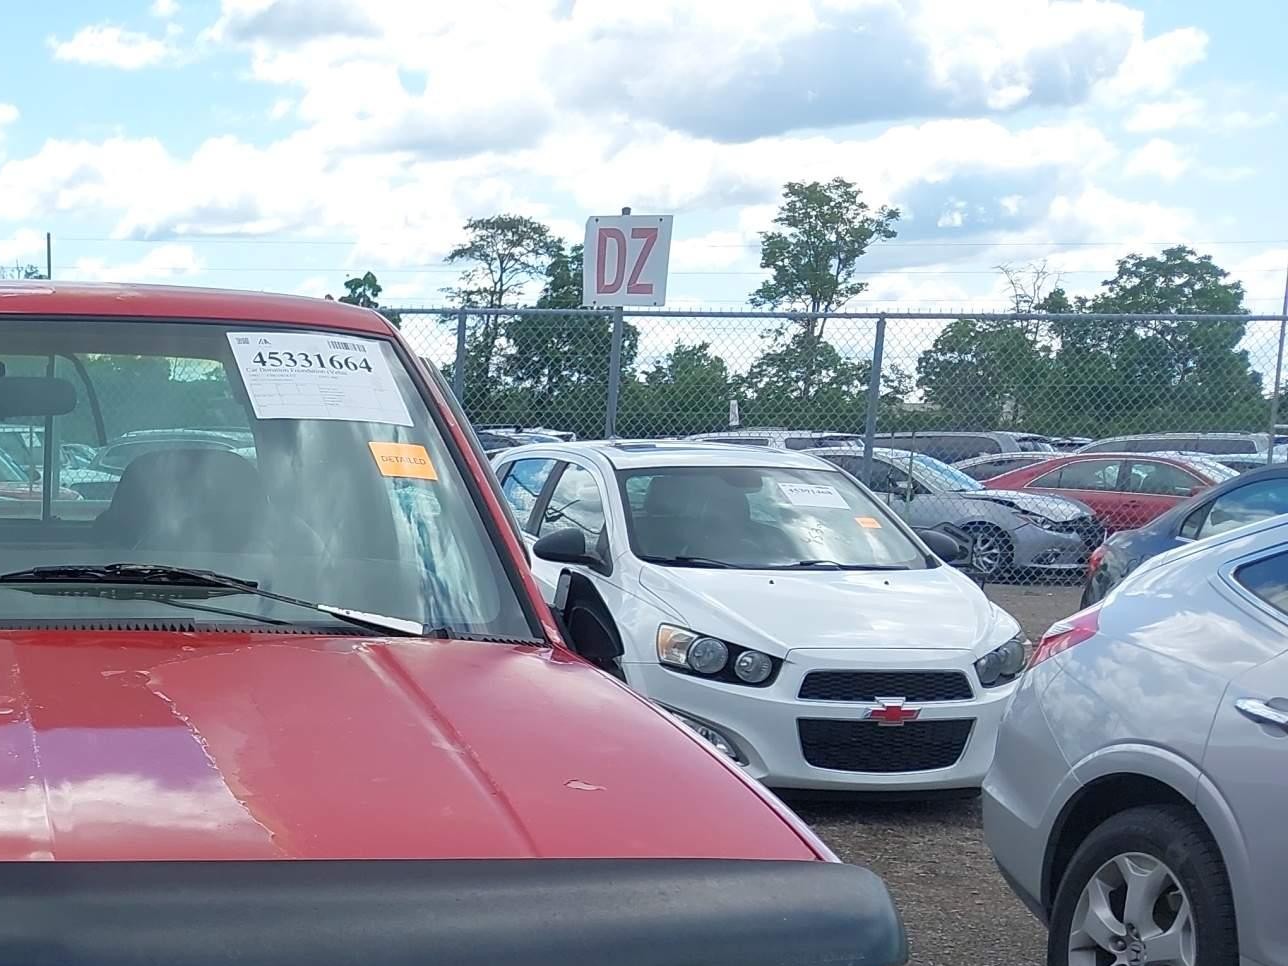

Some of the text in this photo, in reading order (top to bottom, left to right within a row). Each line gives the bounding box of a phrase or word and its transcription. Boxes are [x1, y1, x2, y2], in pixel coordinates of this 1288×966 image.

[596, 227, 659, 295] DZ
[252, 351, 373, 373] 45331664
[380, 455, 427, 465] DETAILED
